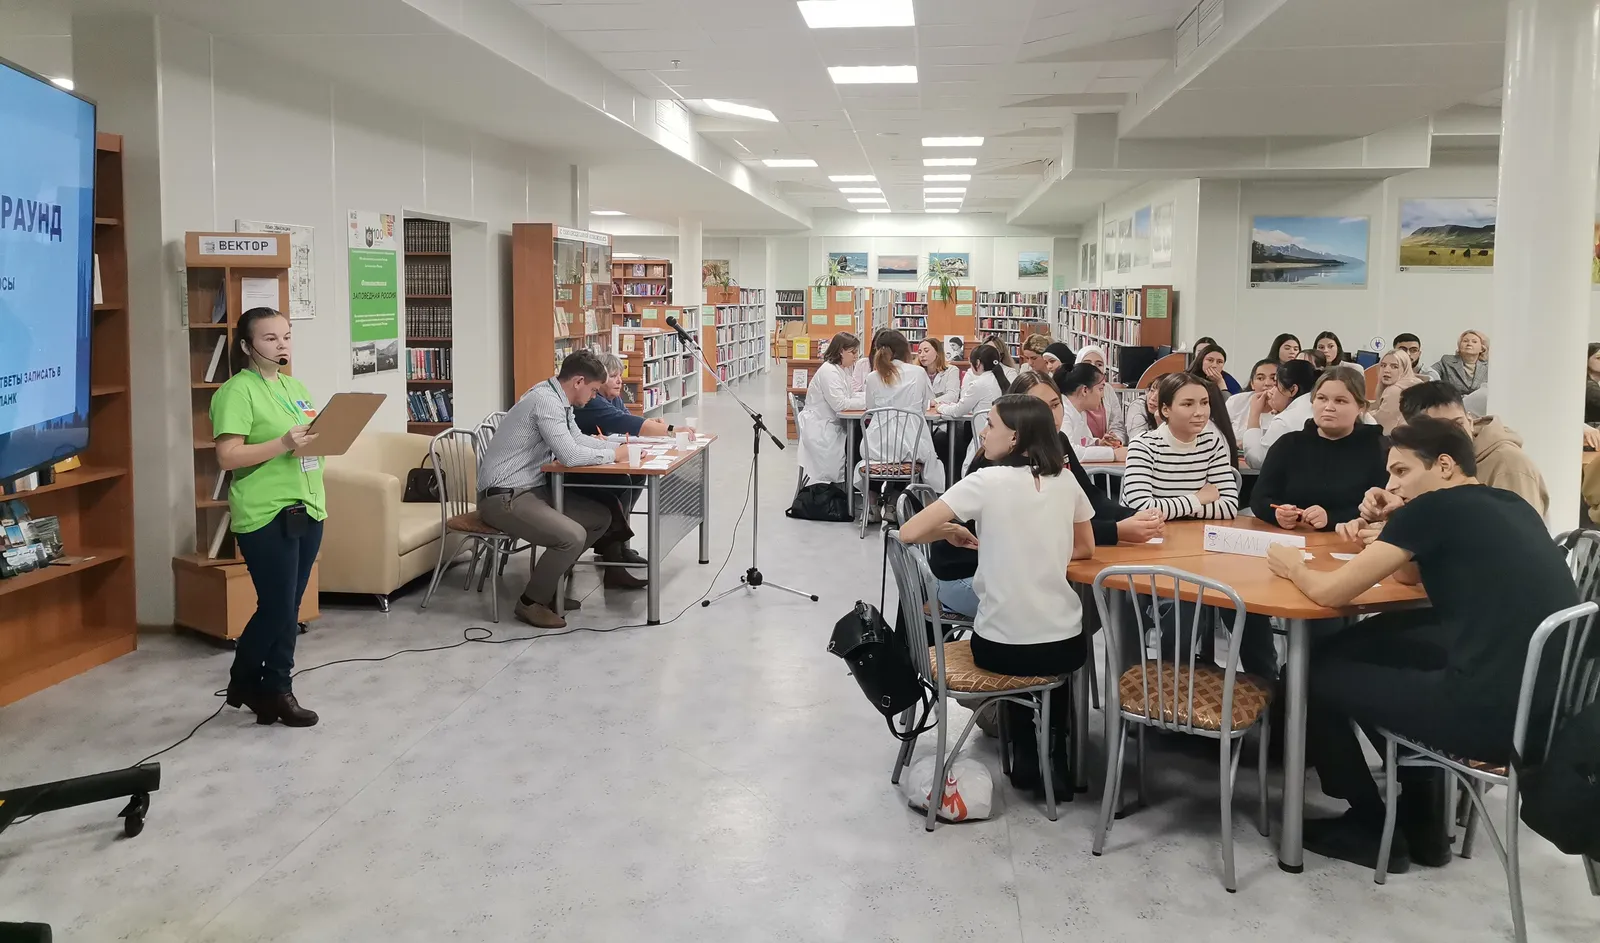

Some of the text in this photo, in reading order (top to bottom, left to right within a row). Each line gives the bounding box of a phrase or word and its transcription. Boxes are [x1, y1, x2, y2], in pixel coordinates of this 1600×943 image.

[1, 195, 62, 242] РАУНД
[219, 240, 269, 251] ВЕКТОР
[0, 276, 15, 291] СЫ
[24, 367, 56, 383] ЗАПИСАТЬ
[57, 366, 61, 377] В
